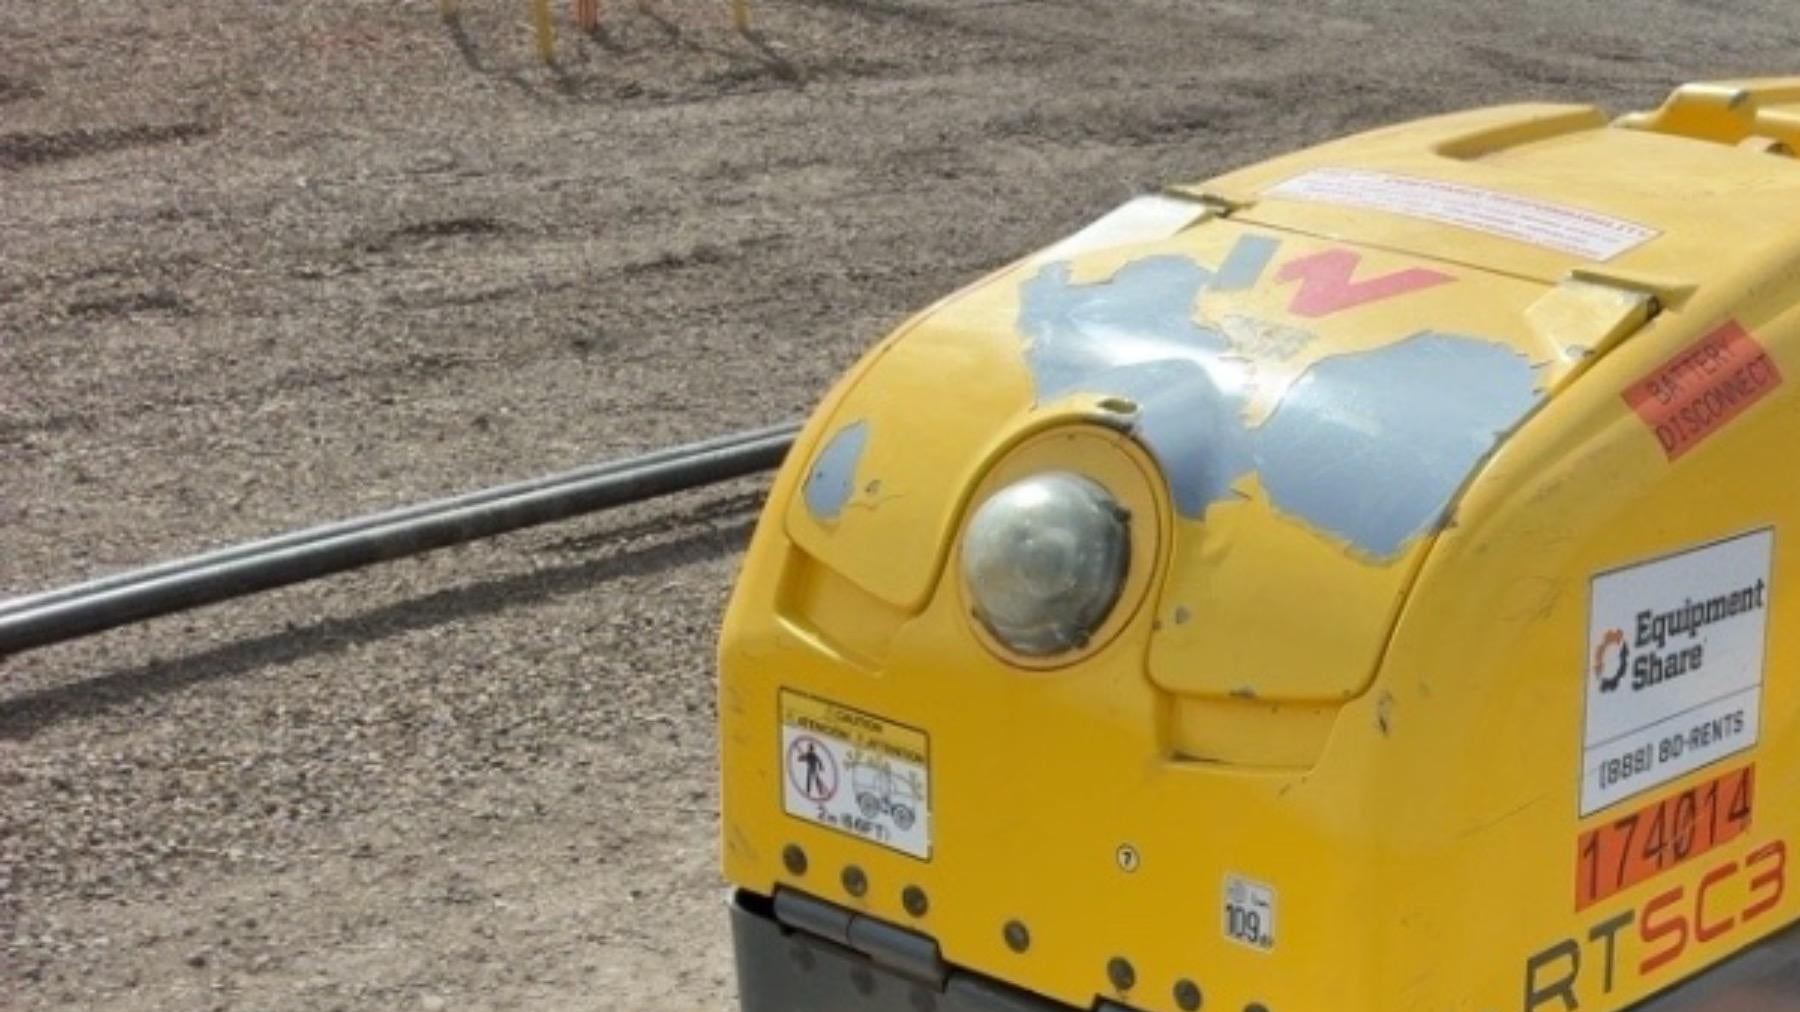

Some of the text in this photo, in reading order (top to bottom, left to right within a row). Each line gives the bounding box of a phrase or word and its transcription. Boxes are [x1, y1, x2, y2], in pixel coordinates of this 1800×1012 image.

[1655, 352, 1770, 453] DISCONNECT
[1634, 577, 1765, 648] Equipment
[1631, 643, 1703, 692] Share
[1599, 710, 1744, 790] (888) 80-RENTS
[1583, 766, 1751, 900] 174014
